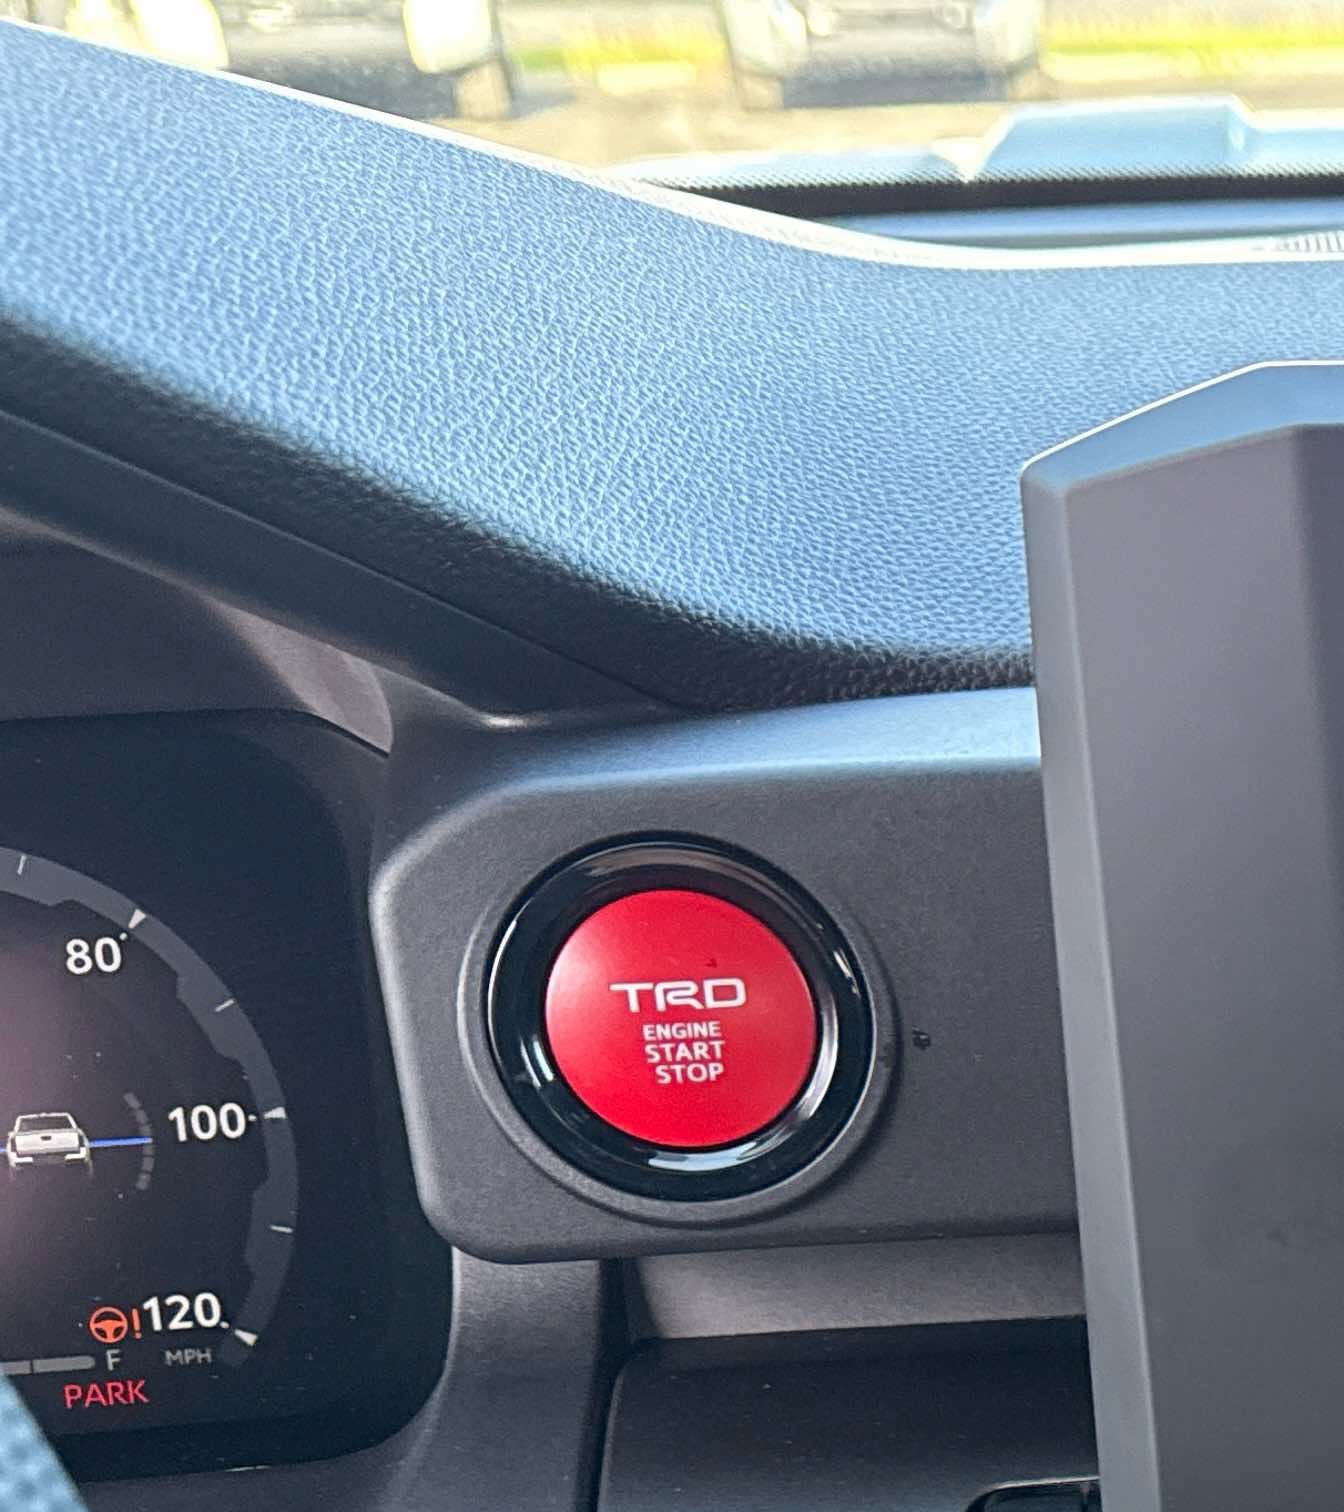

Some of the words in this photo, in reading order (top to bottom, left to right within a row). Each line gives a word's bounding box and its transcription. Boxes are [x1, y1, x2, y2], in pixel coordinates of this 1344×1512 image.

[65, 937, 122, 975] 80
[608, 977, 748, 1012] TRD
[642, 1021, 722, 1041] ENGINE
[644, 1040, 725, 1063] START
[655, 1061, 725, 1085] STOP
[168, 1102, 246, 1142] 100
[143, 1292, 221, 1332] 120
[105, 1350, 121, 1371] F
[165, 1348, 212, 1366] MPH
[63, 1380, 149, 1409] PARK
